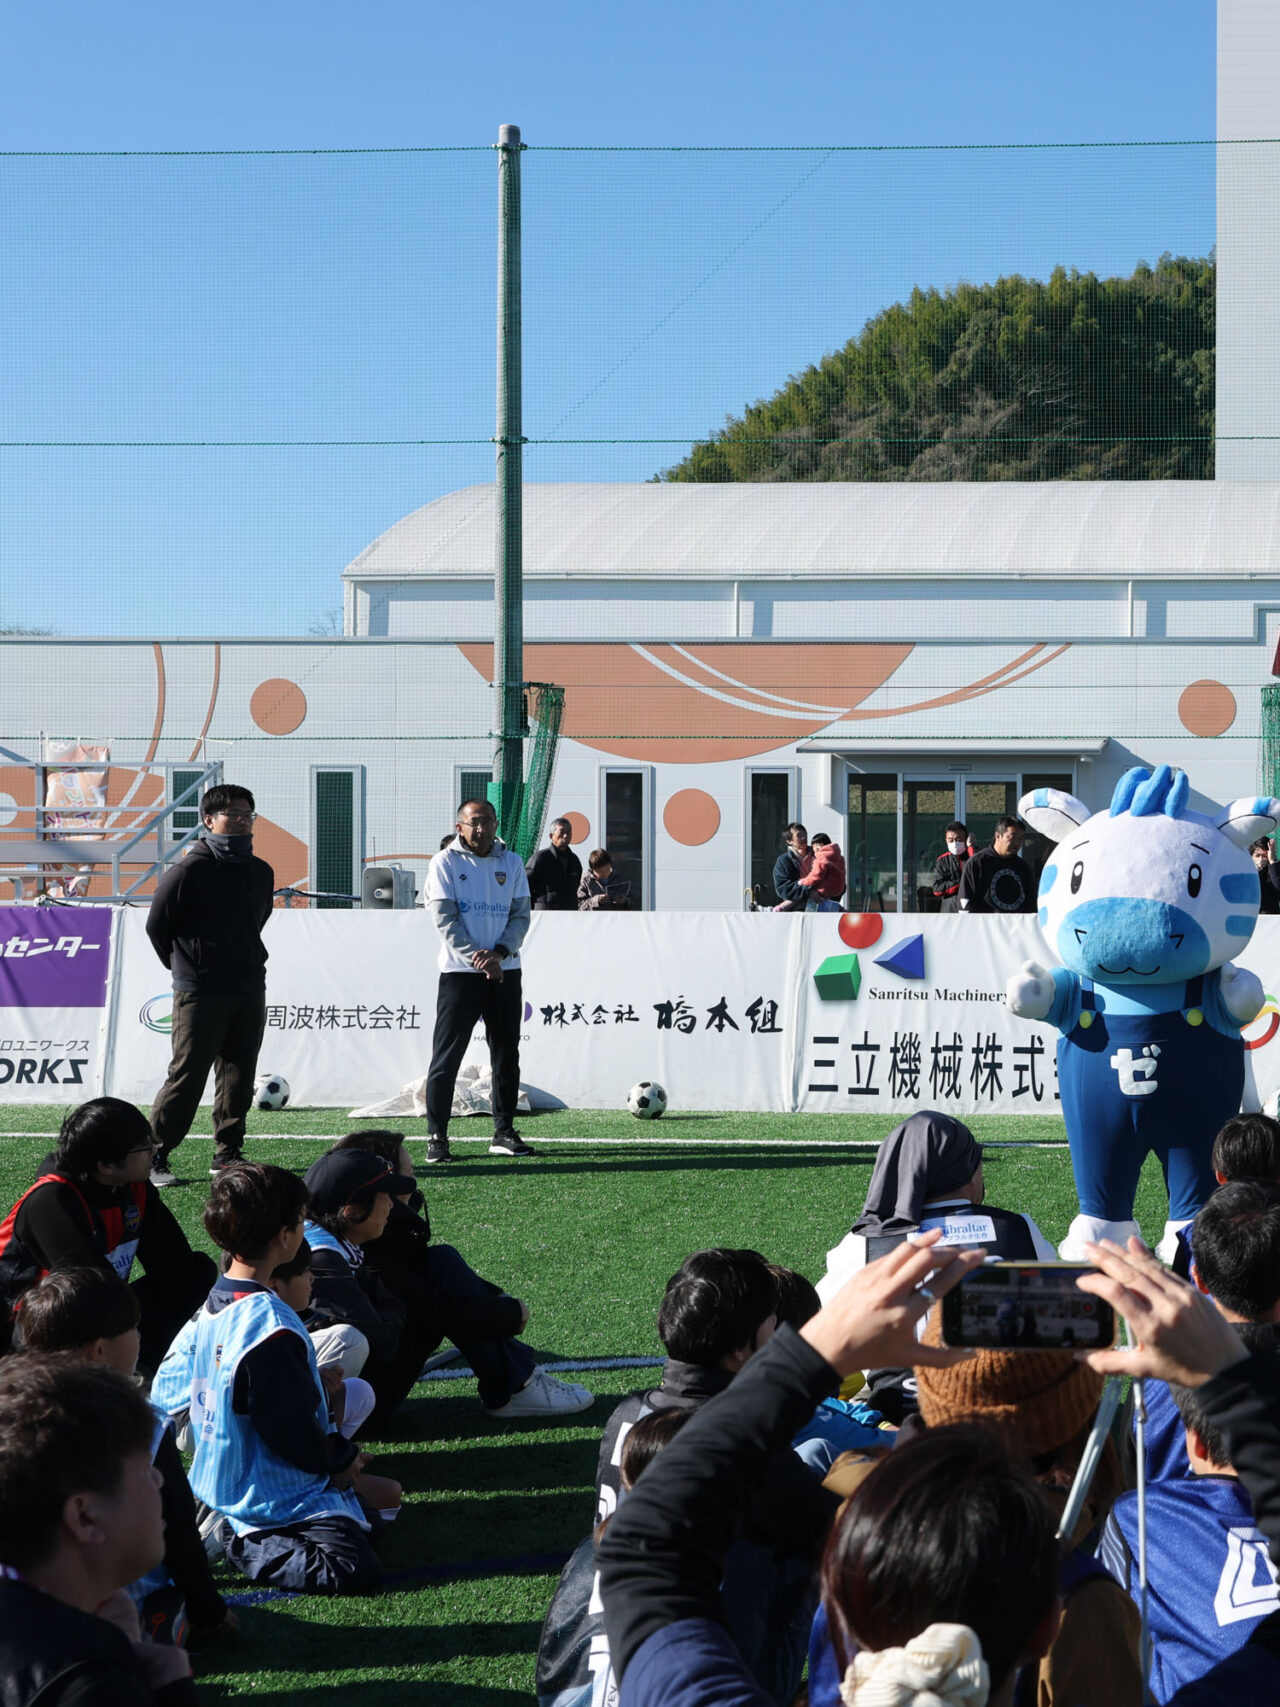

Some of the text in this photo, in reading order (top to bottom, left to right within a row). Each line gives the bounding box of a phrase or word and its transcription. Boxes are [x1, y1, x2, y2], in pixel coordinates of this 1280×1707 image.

[0, 936, 100, 958] センター
[868, 987, 929, 1000] Sanritsu
[540, 995, 783, 1034] 株式会社 橋本組
[0, 1039, 89, 1051] ロユニワークス
[808, 1030, 1060, 1102] 三立機械株式
[942, 1223, 988, 1236] ibraltar
